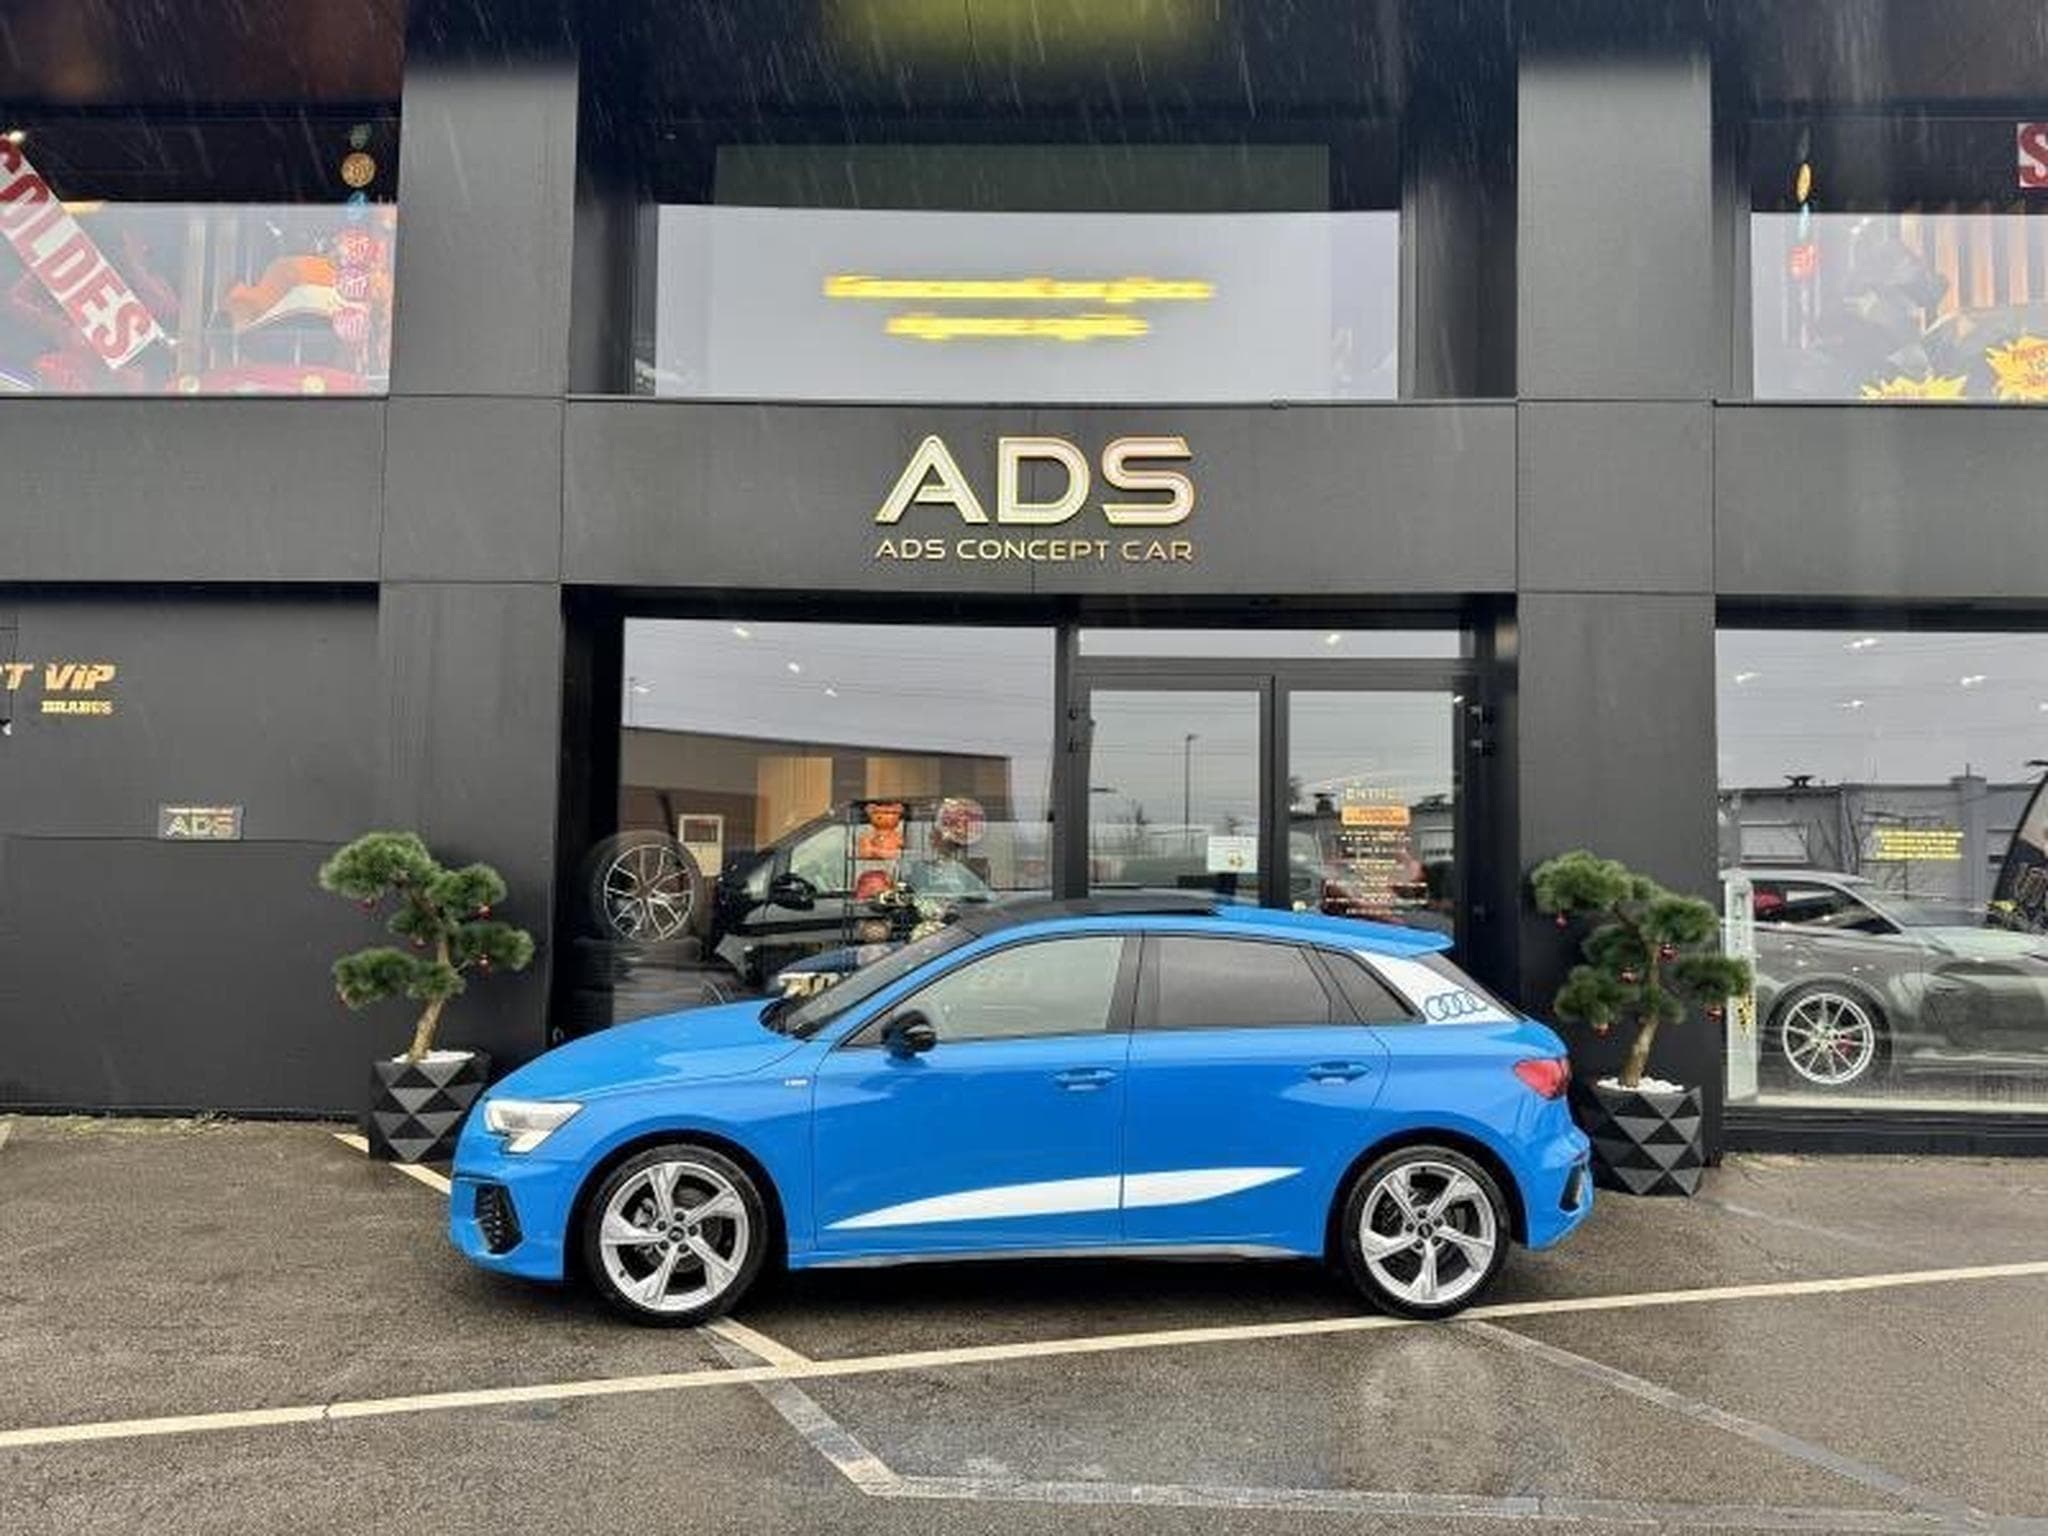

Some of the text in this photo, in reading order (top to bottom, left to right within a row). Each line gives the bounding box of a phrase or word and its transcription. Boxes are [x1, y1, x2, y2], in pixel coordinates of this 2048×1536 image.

[874, 434, 1196, 526] ADS
[874, 539, 1193, 561] ADS CONCEPT CAR
[165, 814, 234, 836] ADS
